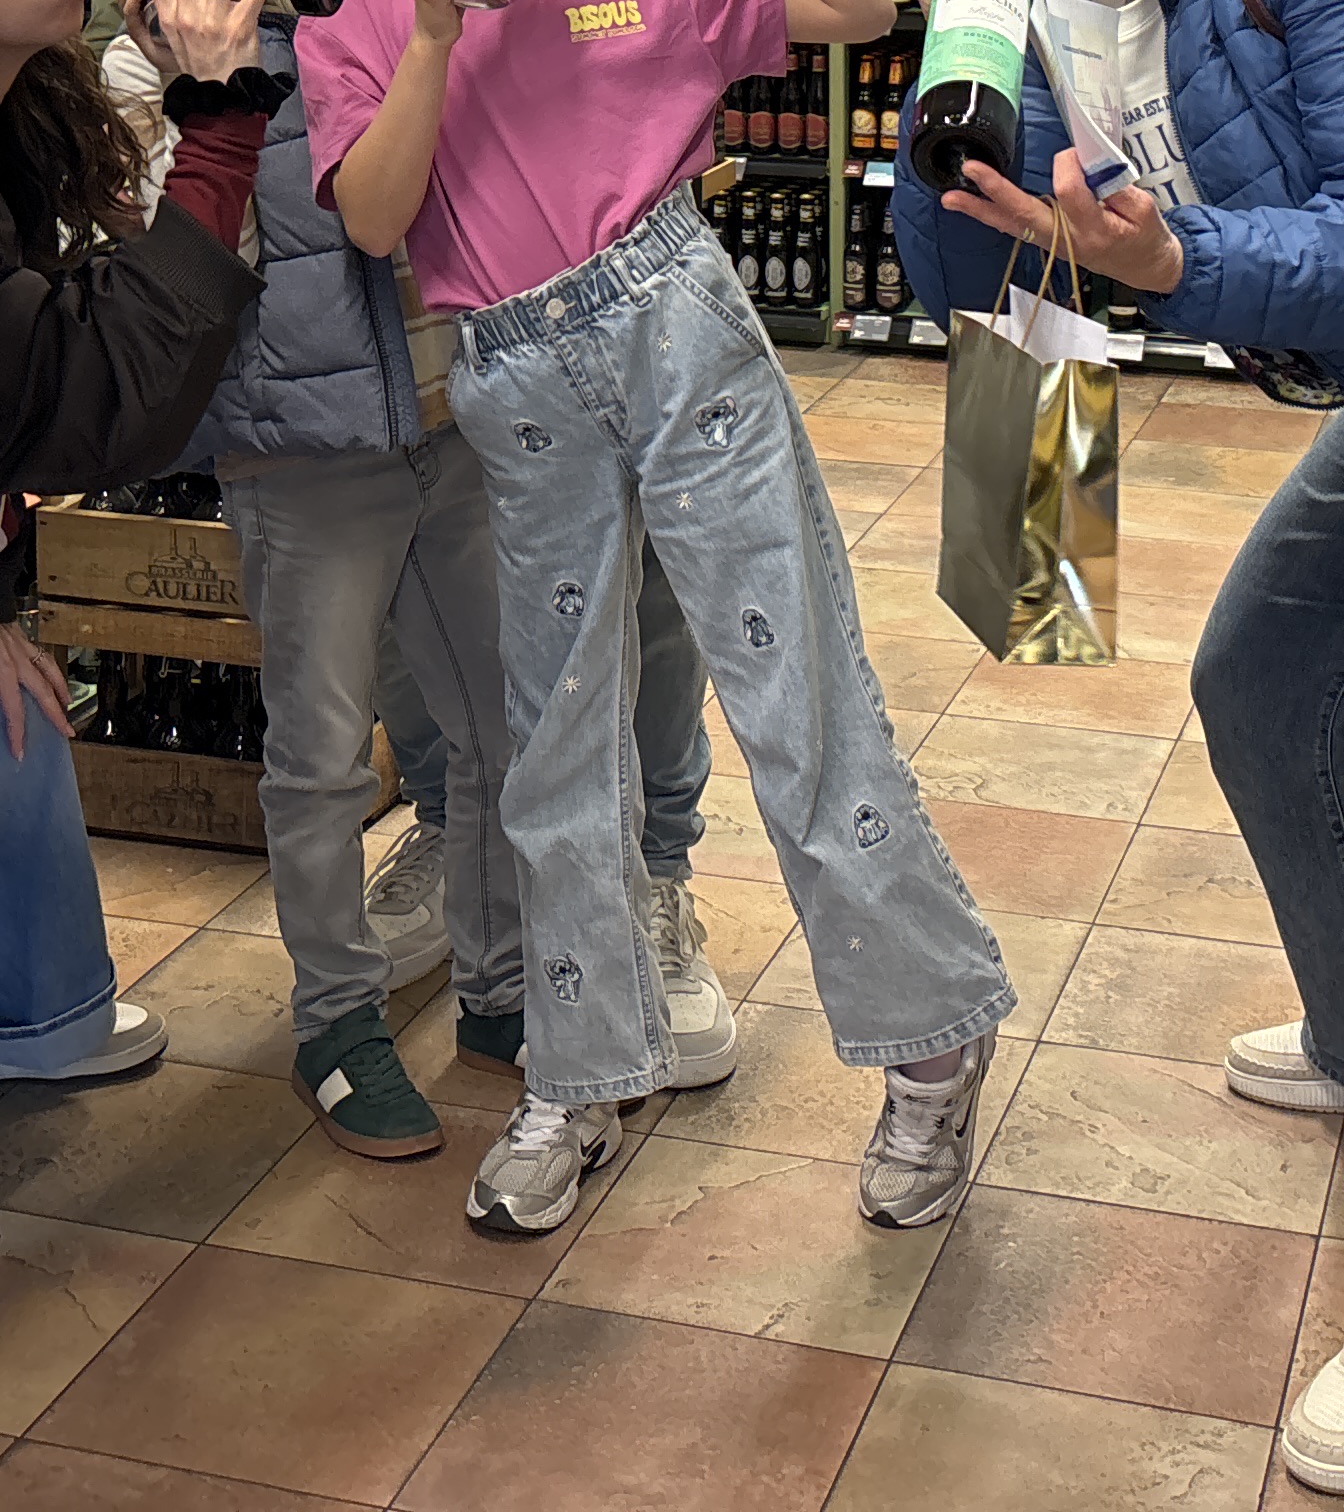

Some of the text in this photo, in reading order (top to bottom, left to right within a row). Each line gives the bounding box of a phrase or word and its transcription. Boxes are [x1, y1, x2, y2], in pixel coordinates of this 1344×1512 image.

[564, 0, 642, 33] BISOUS
[1122, 106, 1145, 127] EAR
[125, 571, 240, 606] CAULIER
